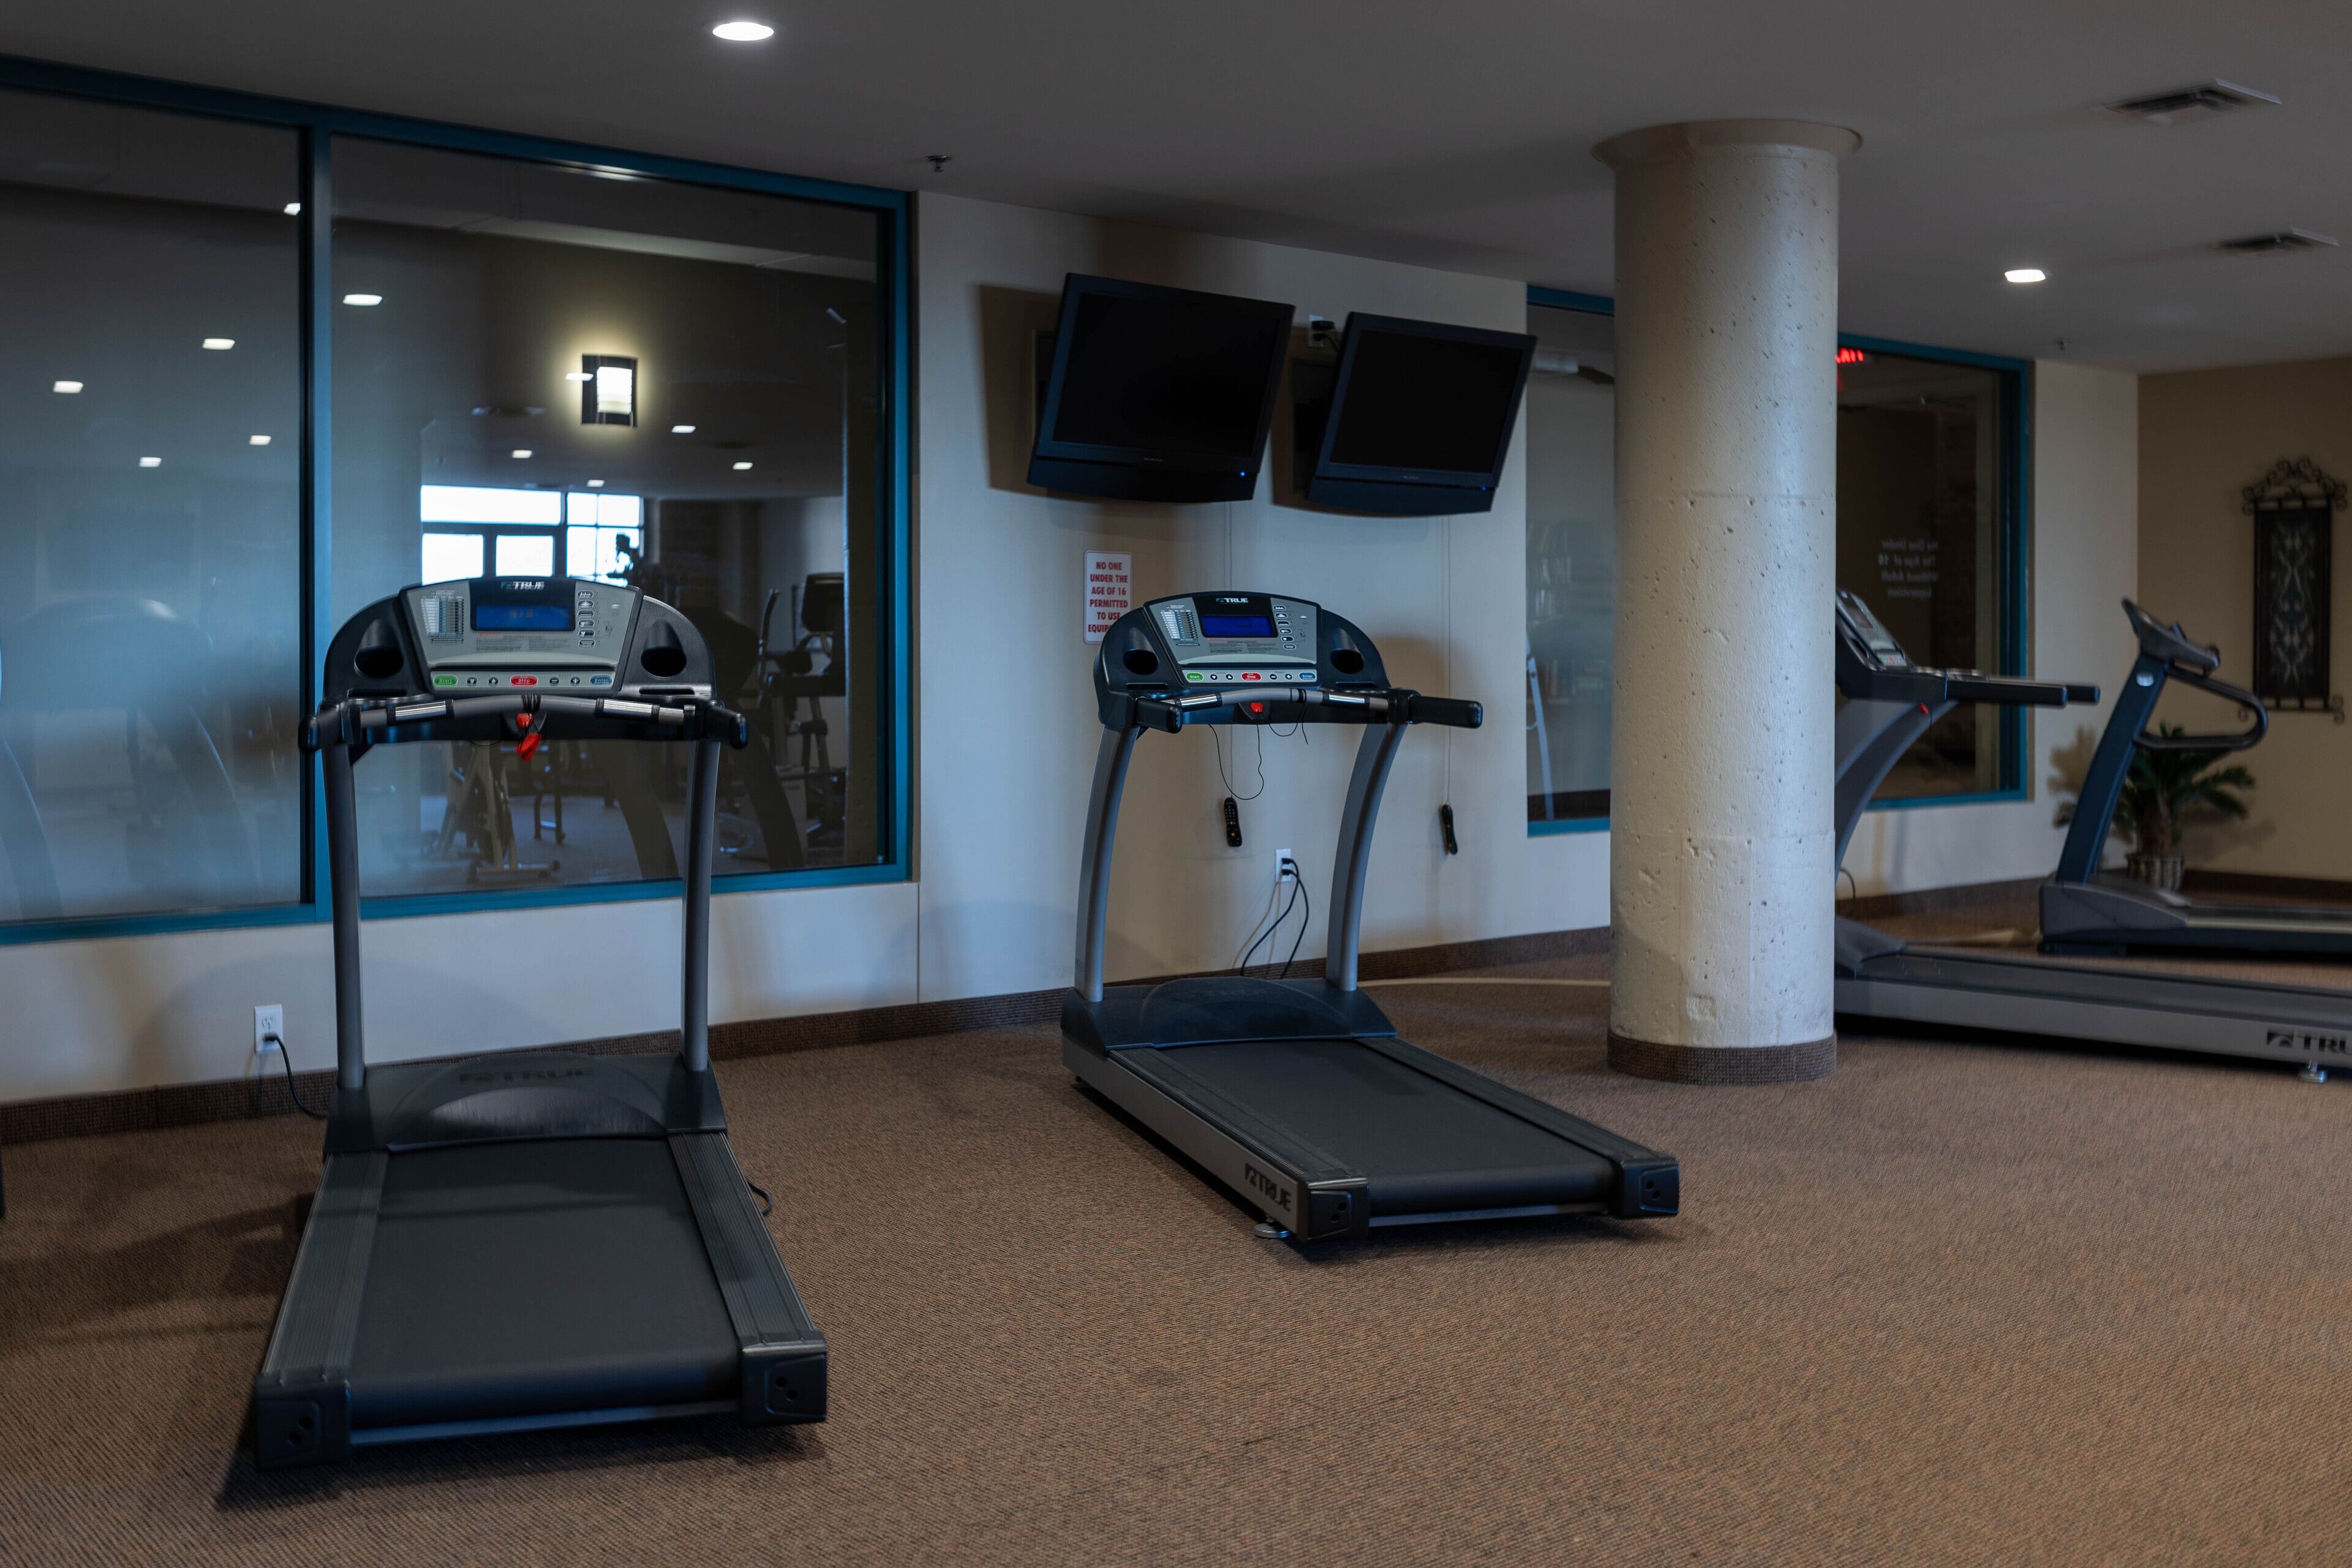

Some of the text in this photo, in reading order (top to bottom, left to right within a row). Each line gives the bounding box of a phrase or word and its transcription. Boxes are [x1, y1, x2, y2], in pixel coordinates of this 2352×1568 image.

[1096, 562, 1122, 570] NO ONE
[513, 581, 545, 590] TRUE
[1090, 599, 1128, 608] PERMITTED
[1088, 624, 1112, 633] EQUIP
[494, 1069, 594, 1081] TRUE
[1257, 1170, 1291, 1212] TRUE
